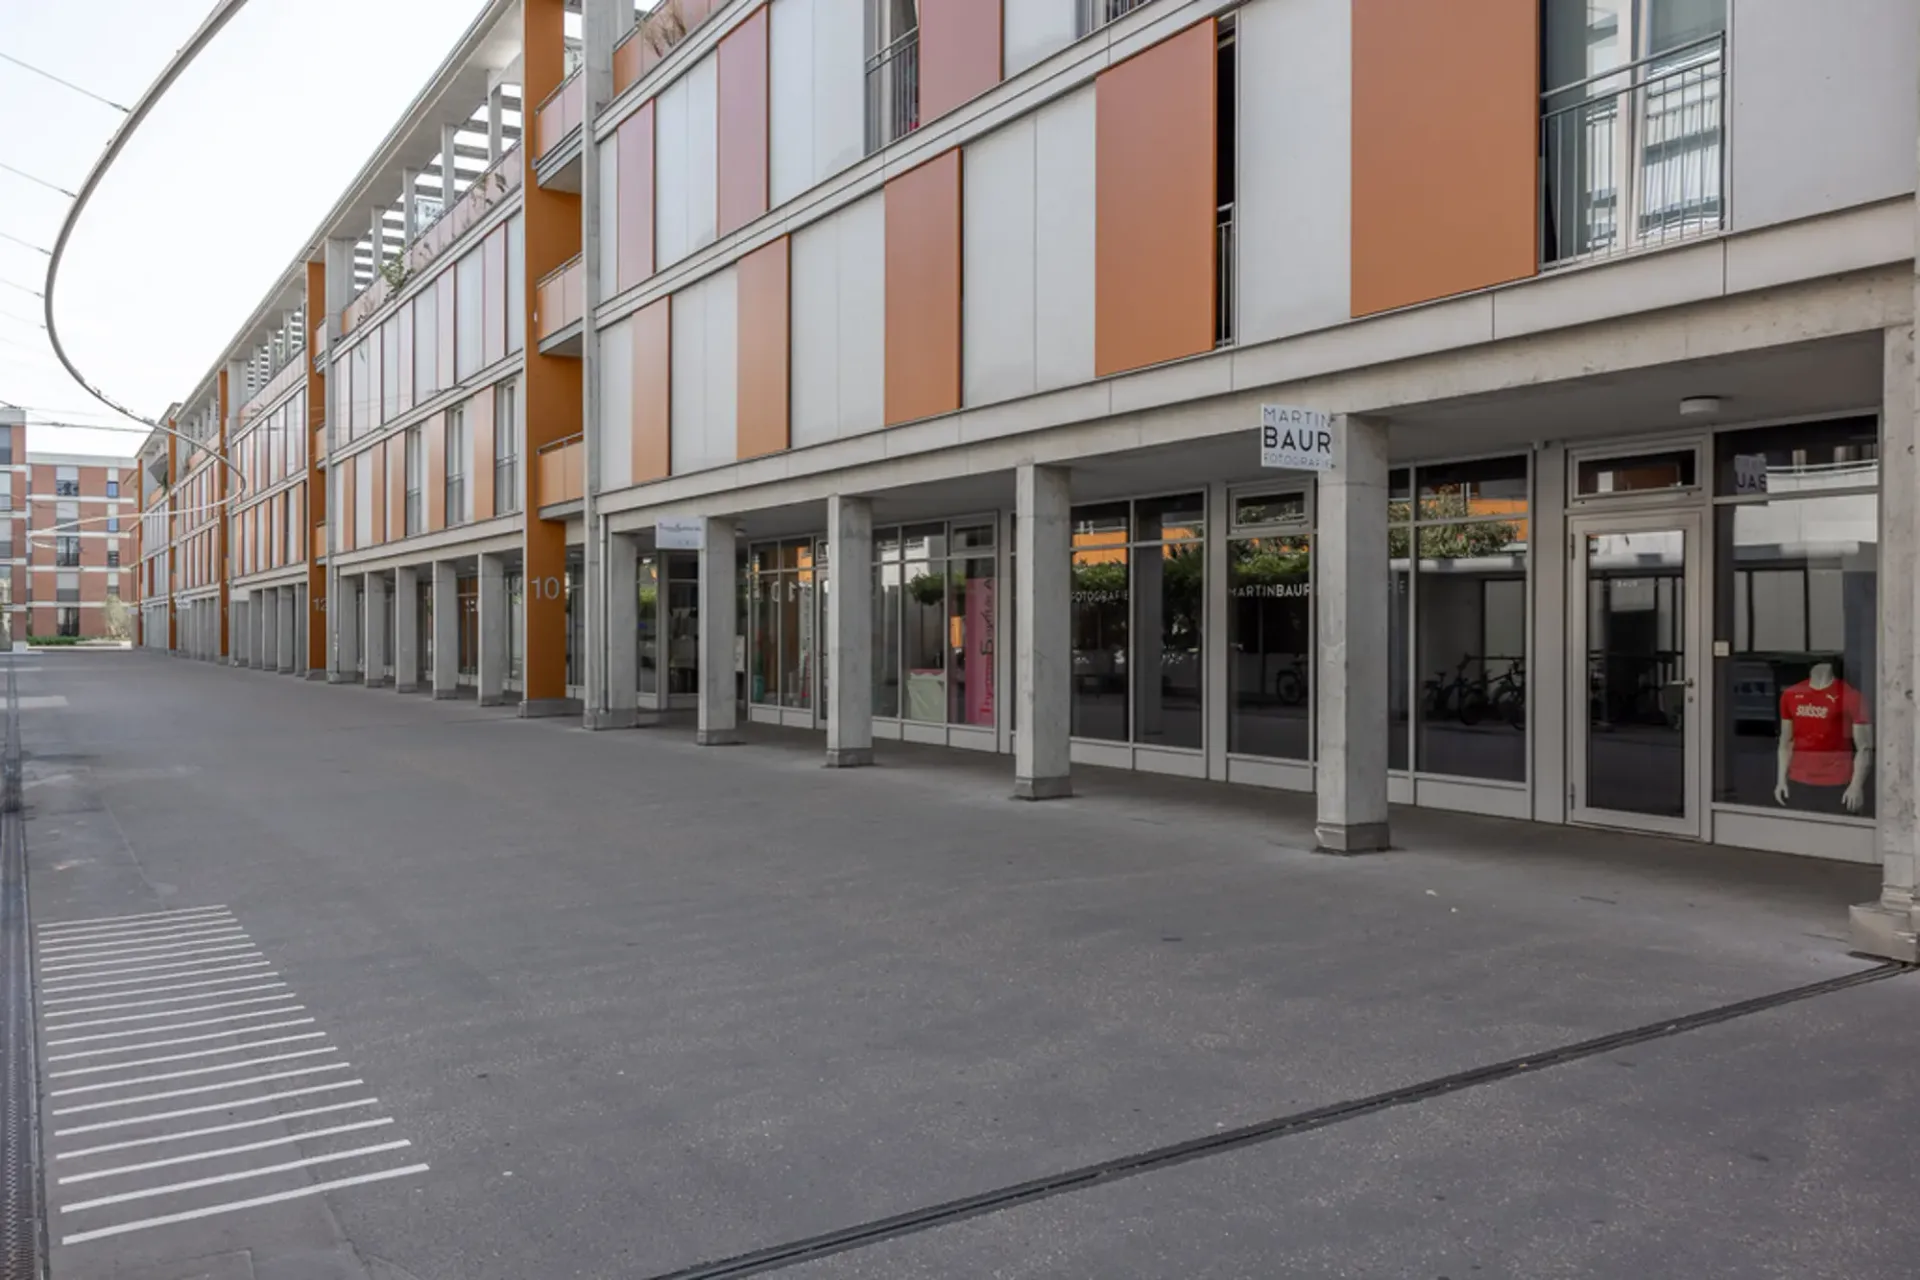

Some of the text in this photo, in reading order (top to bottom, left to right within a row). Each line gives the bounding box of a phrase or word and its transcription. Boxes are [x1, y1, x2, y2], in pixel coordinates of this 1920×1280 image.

[1263, 407, 1331, 427] MARTIN
[1263, 426, 1331, 454] BAUR
[530, 576, 559, 600] 10
